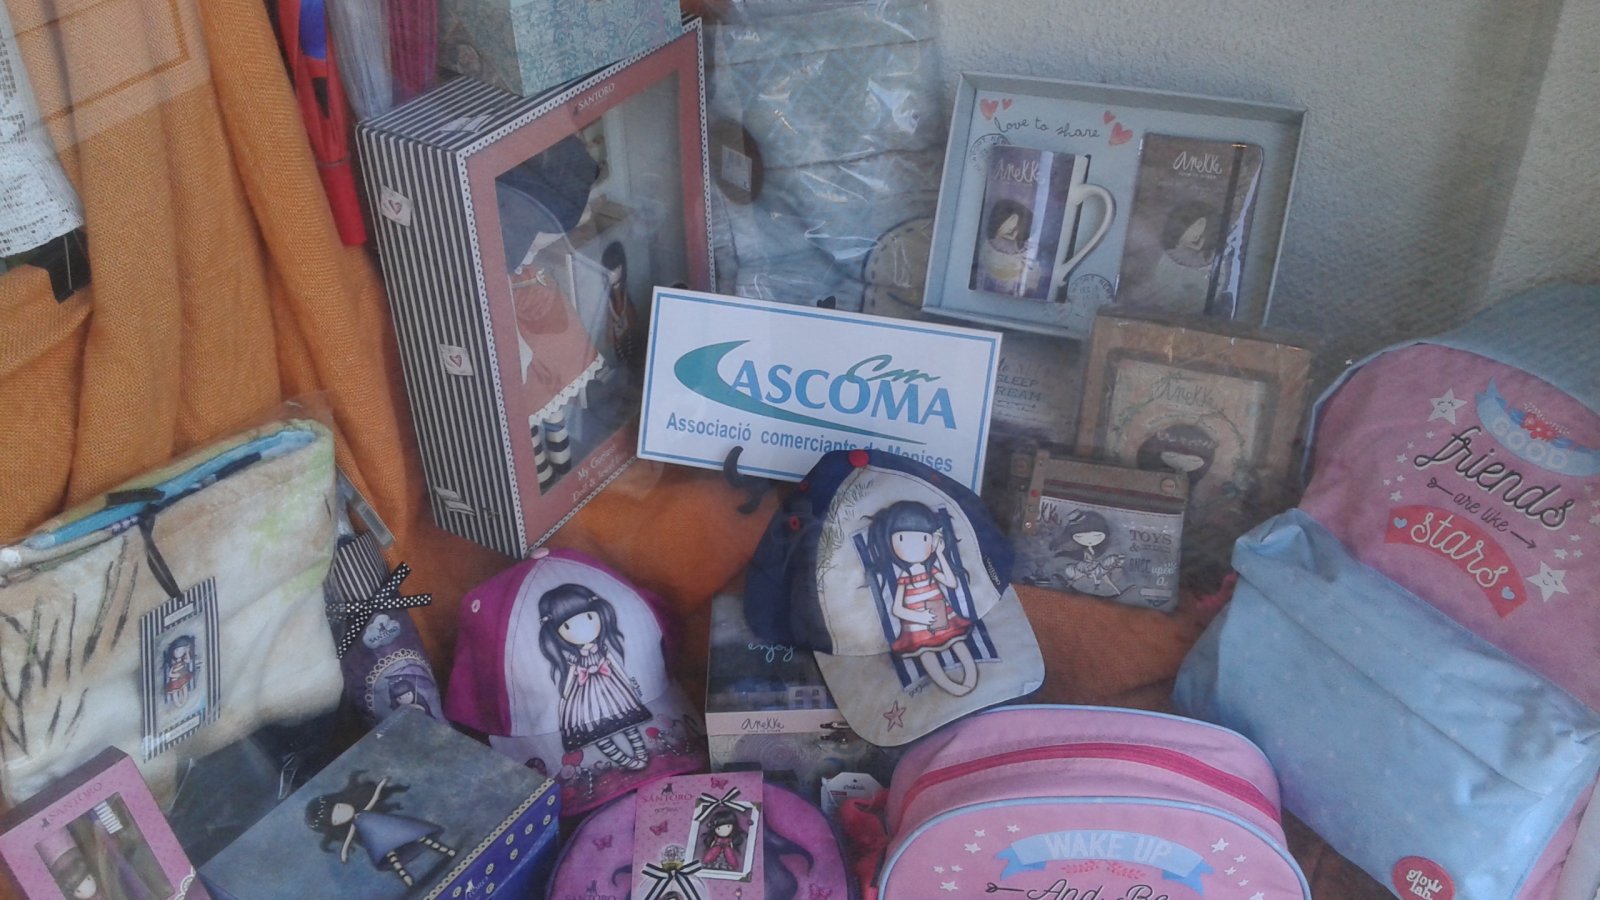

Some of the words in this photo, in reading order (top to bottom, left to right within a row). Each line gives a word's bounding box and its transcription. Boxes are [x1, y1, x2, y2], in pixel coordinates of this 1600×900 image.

[578, 82, 616, 110] SANTORO
[1035, 116, 1050, 131] to
[1055, 123, 1100, 138] share
[728, 360, 957, 429] ASCOMA
[995, 386, 1041, 402] REAM
[666, 412, 752, 441] Associació
[1492, 415, 1569, 469] GOOD
[1414, 426, 1574, 530] friends
[1453, 492, 1481, 514] are
[1480, 506, 1509, 533] like
[1129, 529, 1172, 546] TOYS
[1411, 512, 1509, 588] stars
[747, 642, 794, 663] enjoy
[644, 792, 694, 804] SANTORO
[1043, 831, 1125, 859] WAKE
[1133, 836, 1173, 862] UP
